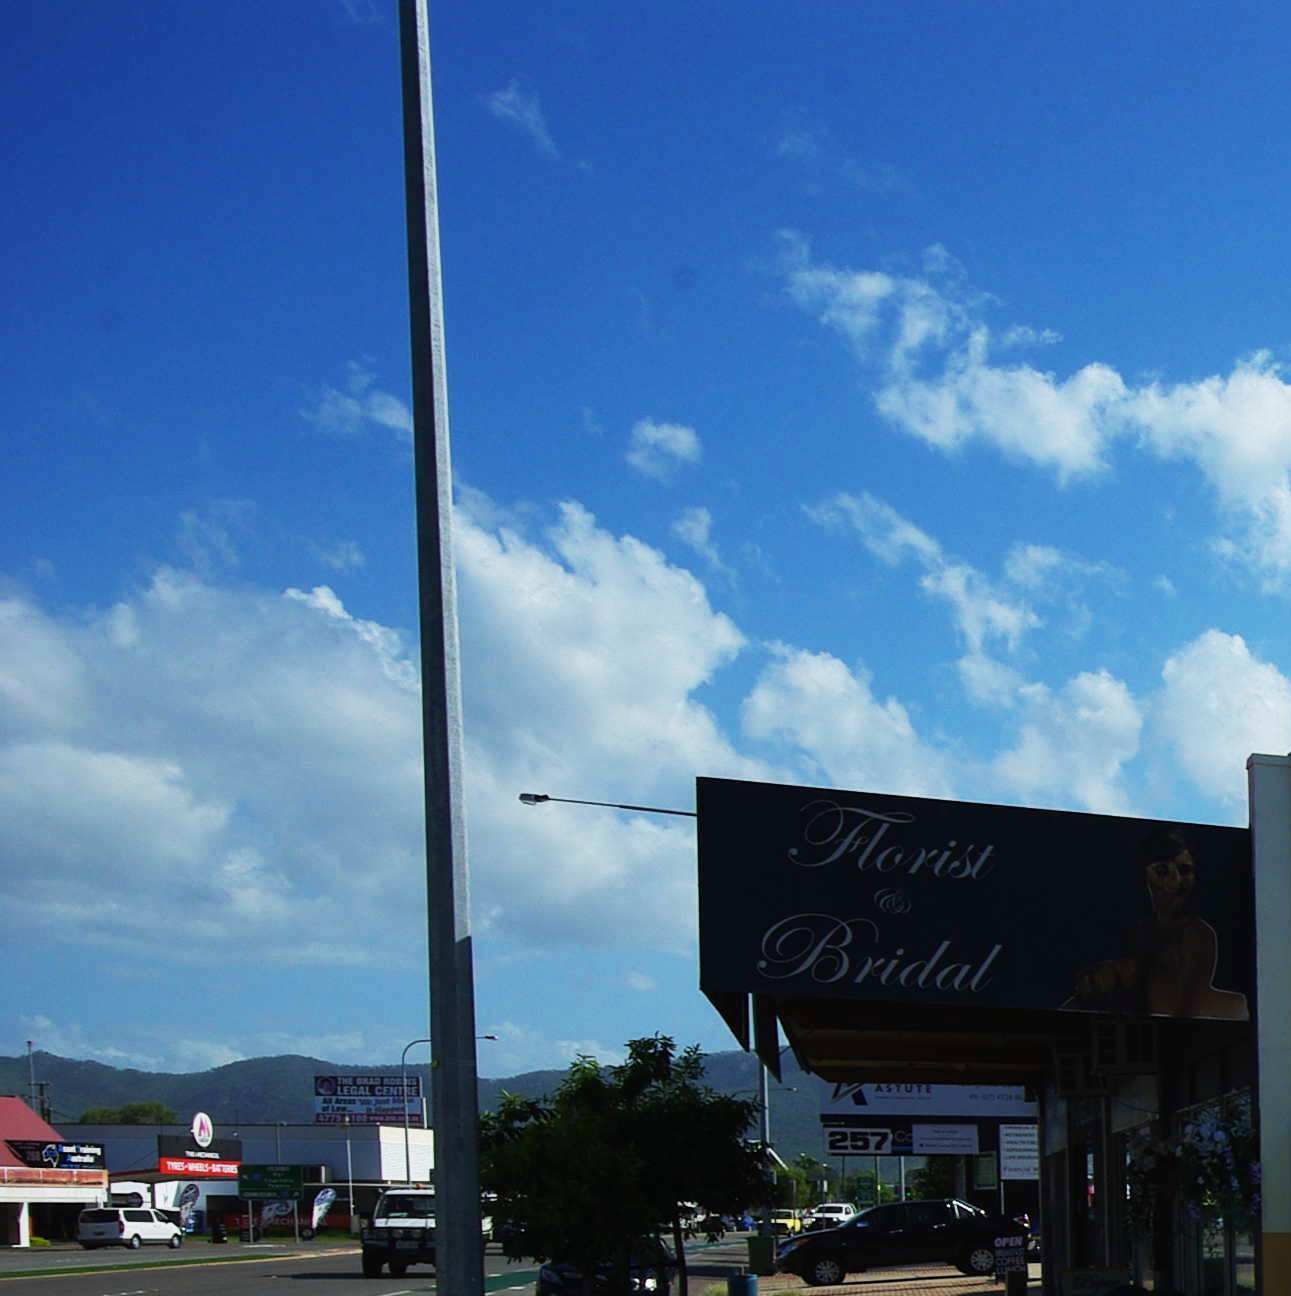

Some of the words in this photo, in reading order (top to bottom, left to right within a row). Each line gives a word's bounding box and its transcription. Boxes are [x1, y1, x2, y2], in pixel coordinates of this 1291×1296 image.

[787, 800, 994, 879] Florist
[874, 888, 912, 914] &
[757, 913, 1003, 992] Bridal
[337, 1086, 371, 1096] LEGAL
[875, 1084, 932, 1093] ASTUTE
[828, 1131, 888, 1151] 257
[994, 1236, 1023, 1248] OPEN
